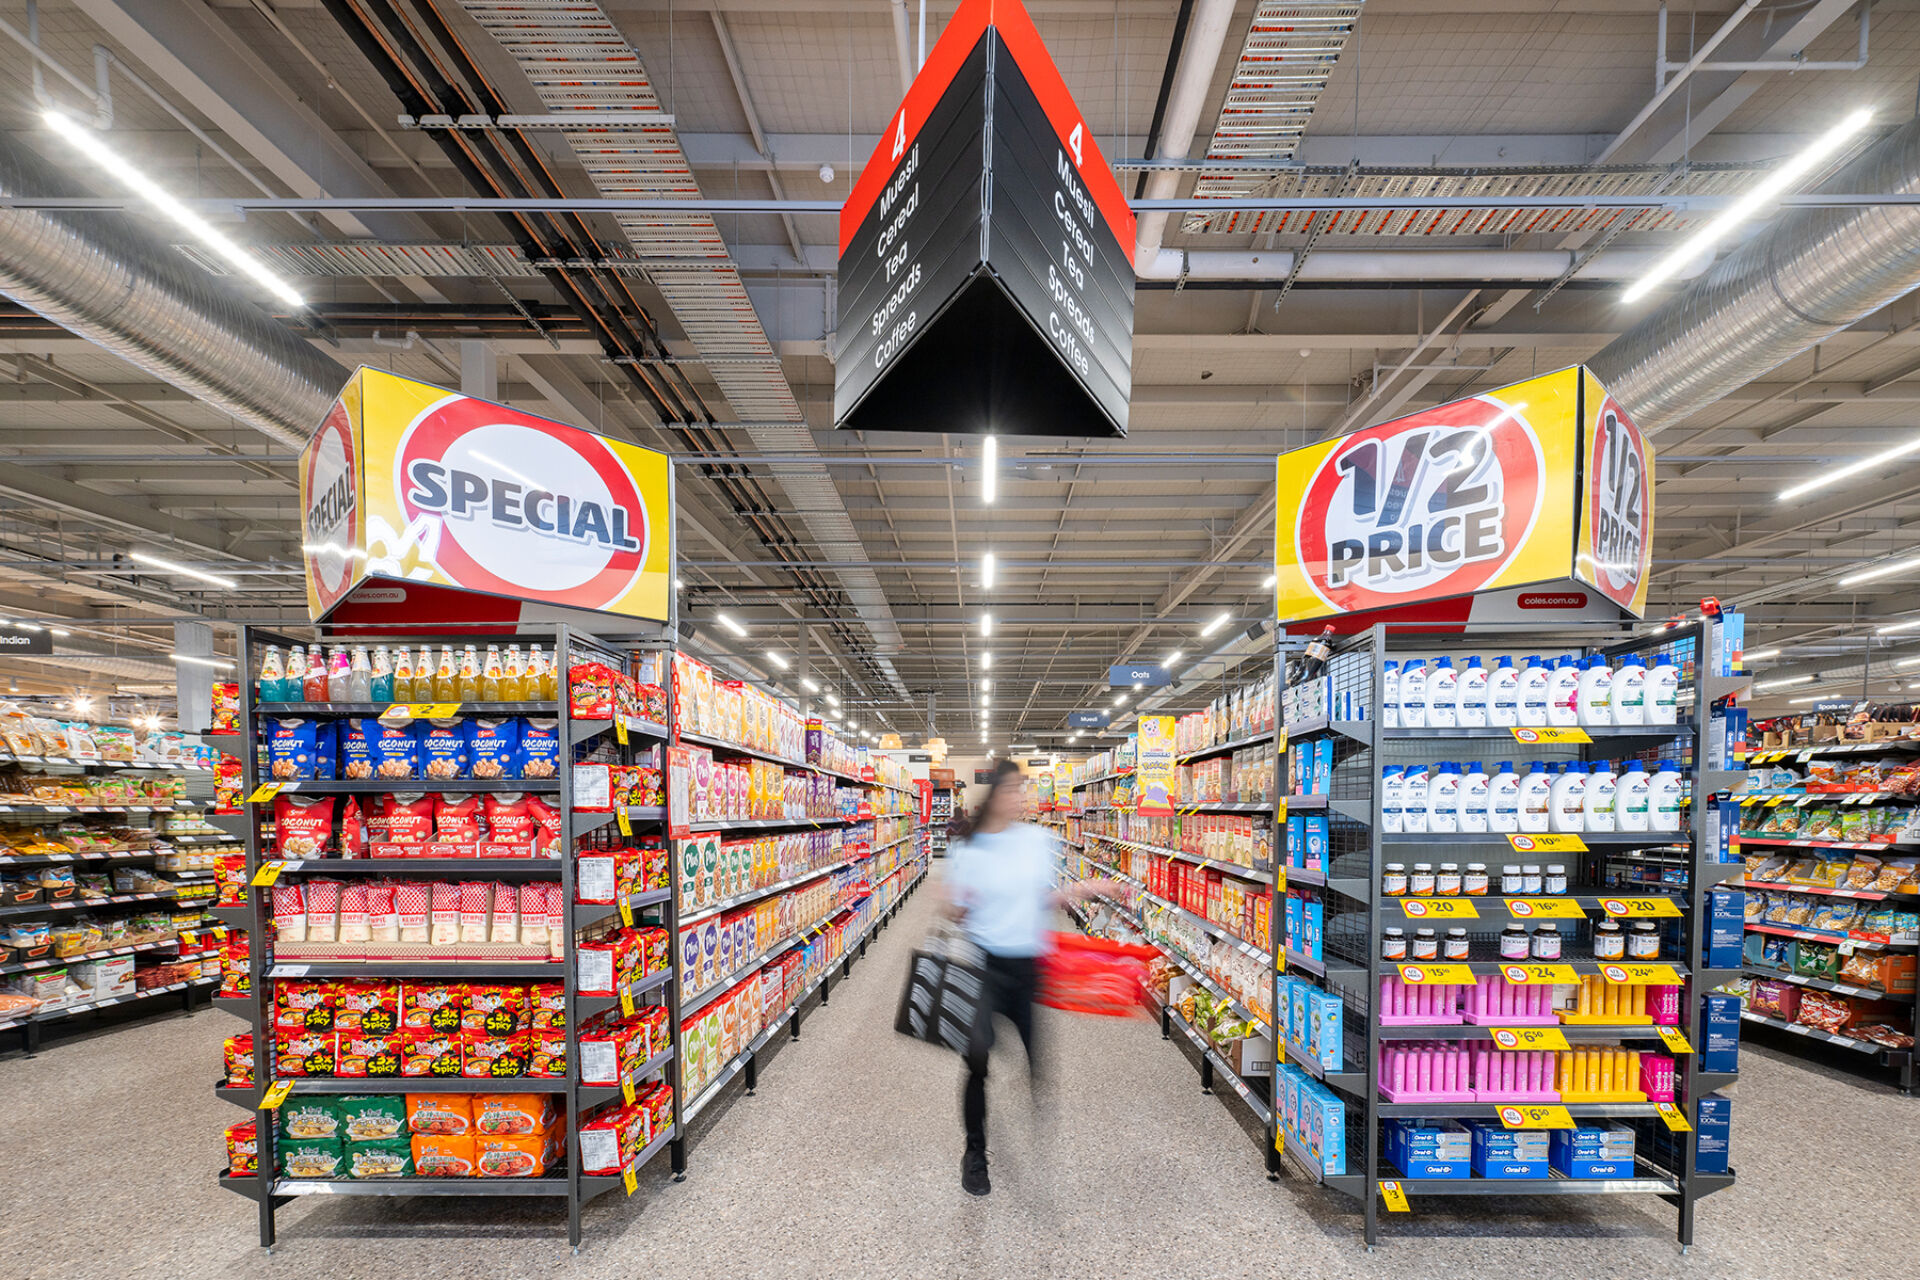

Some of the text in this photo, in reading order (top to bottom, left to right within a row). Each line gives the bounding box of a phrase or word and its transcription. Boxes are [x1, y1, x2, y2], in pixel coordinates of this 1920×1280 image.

[891, 108, 906, 162] 4
[1069, 122, 1083, 168] 4
[880, 143, 919, 221] Muesli
[1057, 149, 1094, 229] Muesli
[877, 183, 919, 258] Cereal
[1054, 190, 1094, 267] Cereal
[885, 240, 908, 284] Tea
[1062, 241, 1084, 291] Tea
[872, 262, 921, 338] Spreads
[1048, 264, 1095, 345] Spreads
[874, 311, 916, 370] Coffee
[1049, 311, 1089, 375] Coffee
[1604, 411, 1641, 519] 1/2
[1338, 427, 1490, 528] 1/2
[307, 461, 356, 538] SPECIAL
[410, 461, 640, 550] SPECIAL
[1330, 507, 1501, 584] PRICE
[1598, 505, 1639, 584] PRICE
[351, 591, 399, 599] coles.com.au
[1524, 596, 1579, 605] coles.com.au
[1131, 671, 1150, 679] Oats
[1818, 703, 1838, 711] Sports
[378, 740, 416, 748] COCONUT
[424, 739, 464, 748] COCONUT
[470, 739, 506, 748] COCONUT
[686, 852, 699, 871] Plus
[706, 848, 716, 866] Plus
[1427, 901, 1454, 912] $20
[1626, 900, 1656, 912] $20
[686, 940, 698, 960] Plus
[1528, 966, 1556, 978] $24
[312, 1006, 330, 1018] 3x
[370, 1008, 390, 1021] 3x
[441, 1005, 458, 1018] 3x
[496, 1008, 512, 1022] 3x
[306, 1014, 330, 1030] Spicy
[362, 1018, 390, 1030] Spicy
[432, 1014, 458, 1026] Spicy
[486, 1018, 512, 1030] Spicy
[314, 1052, 332, 1064] 3x
[376, 1052, 396, 1064] 3x
[441, 1052, 460, 1064] 3x
[500, 1054, 519, 1066] 3x
[305, 1062, 334, 1072] Spicy
[368, 1062, 397, 1074] Spicy
[432, 1062, 460, 1074] Spicy
[492, 1064, 519, 1076] Spicy
[1388, 1190, 1400, 1199] $3
